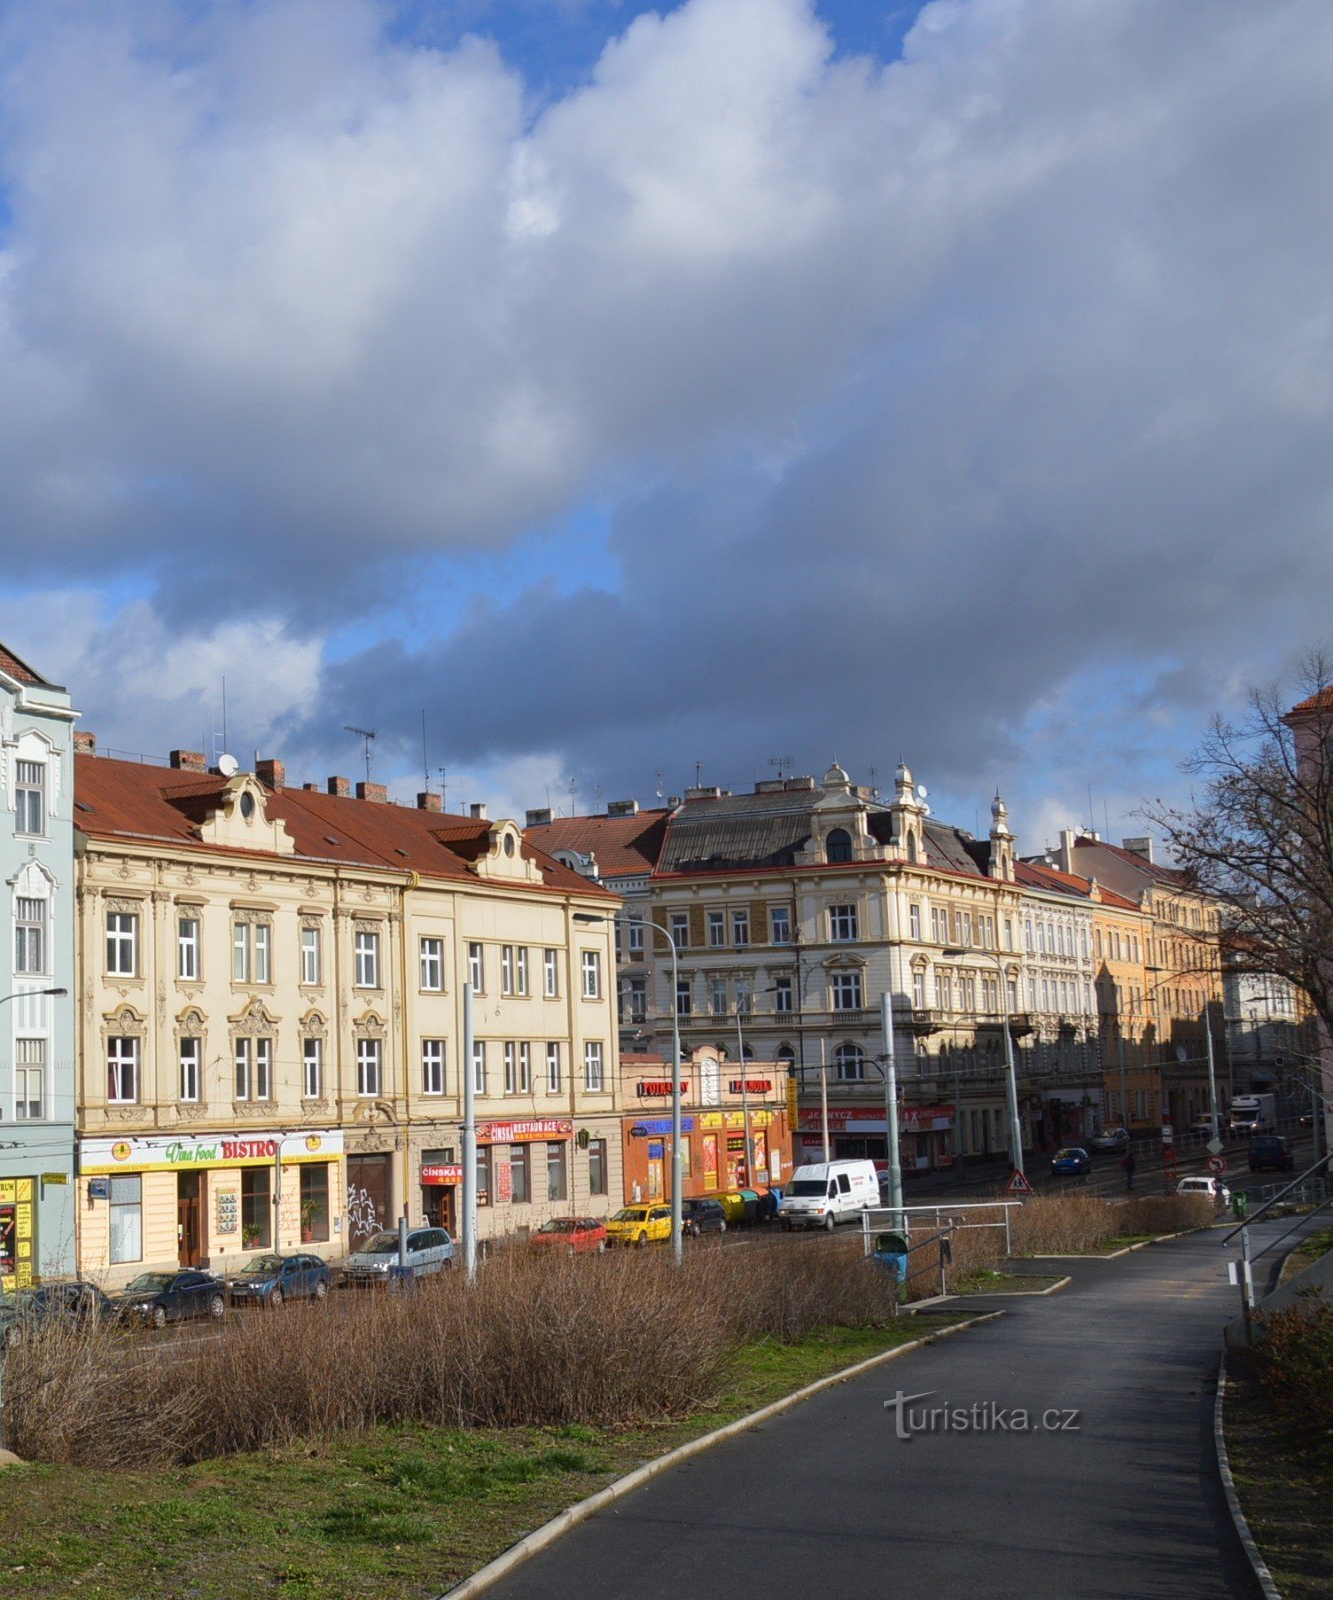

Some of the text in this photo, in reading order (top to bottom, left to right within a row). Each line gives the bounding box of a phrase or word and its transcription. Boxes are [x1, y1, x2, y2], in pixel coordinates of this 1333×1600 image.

[491, 1122, 514, 1142] ČÍNSKÁ
[194, 1143, 217, 1162] food
[222, 1140, 279, 1160] BISTRO
[422, 1167, 456, 1177] ČÍNSKÁ
